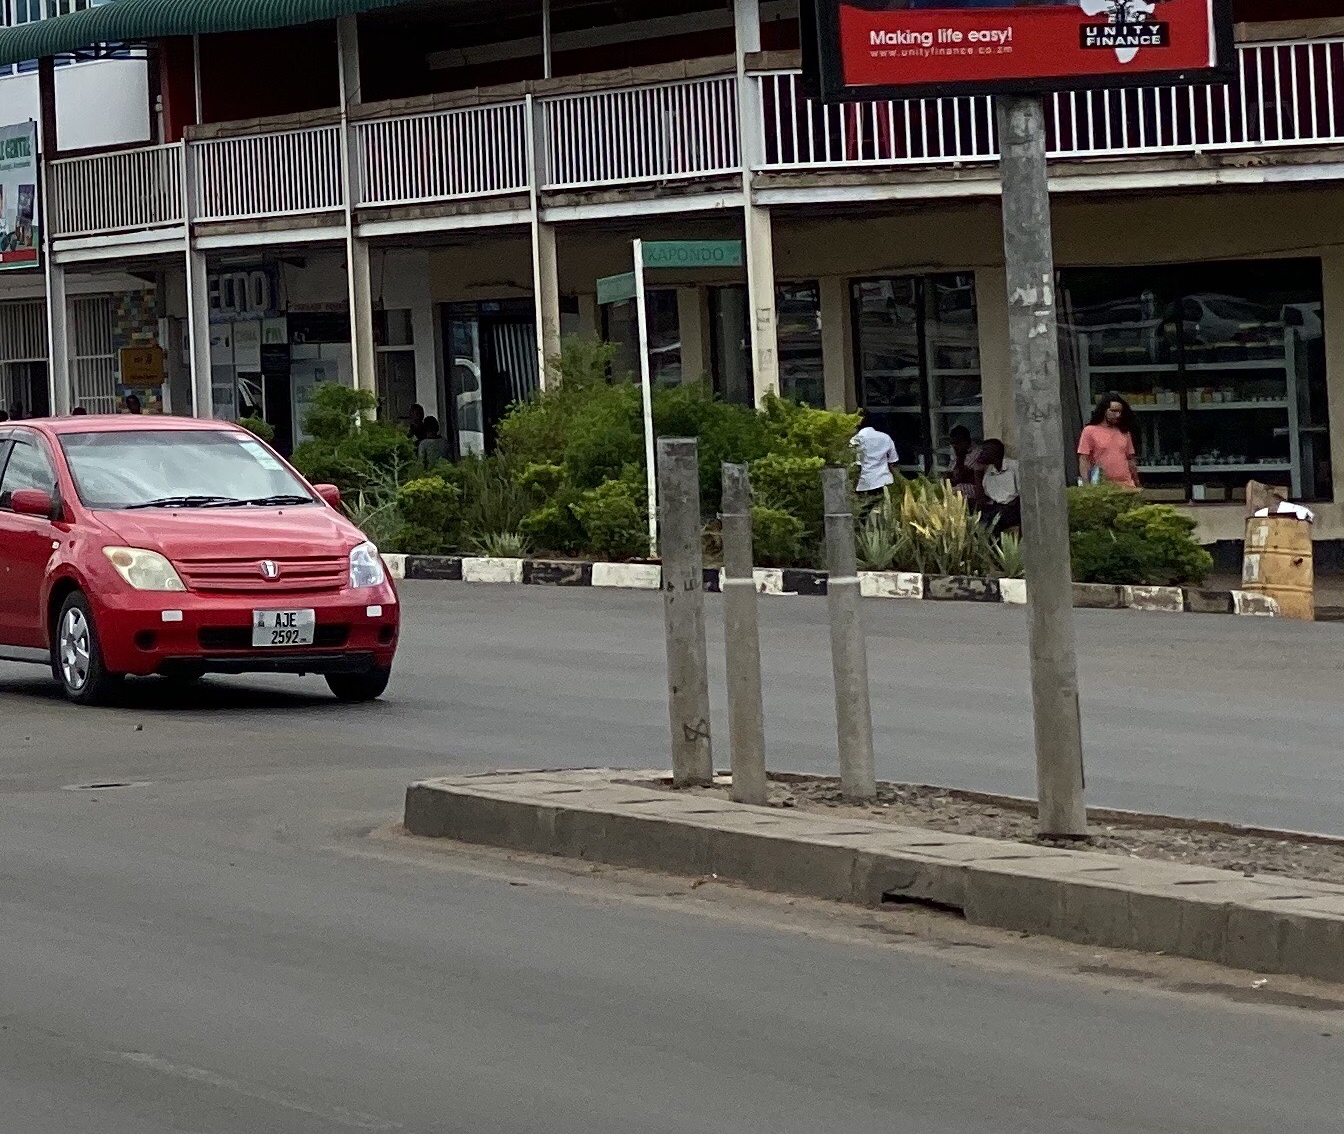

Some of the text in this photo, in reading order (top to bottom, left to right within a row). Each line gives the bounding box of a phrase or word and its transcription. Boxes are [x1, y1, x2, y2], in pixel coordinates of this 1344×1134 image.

[869, 25, 1013, 47] Making life easy!
[1085, 24, 1161, 37] UNITY
[1085, 34, 1162, 47] FINANCE
[647, 247, 725, 262] KAPONDO
[273, 612, 297, 628] AJE
[271, 629, 300, 644] 2592
